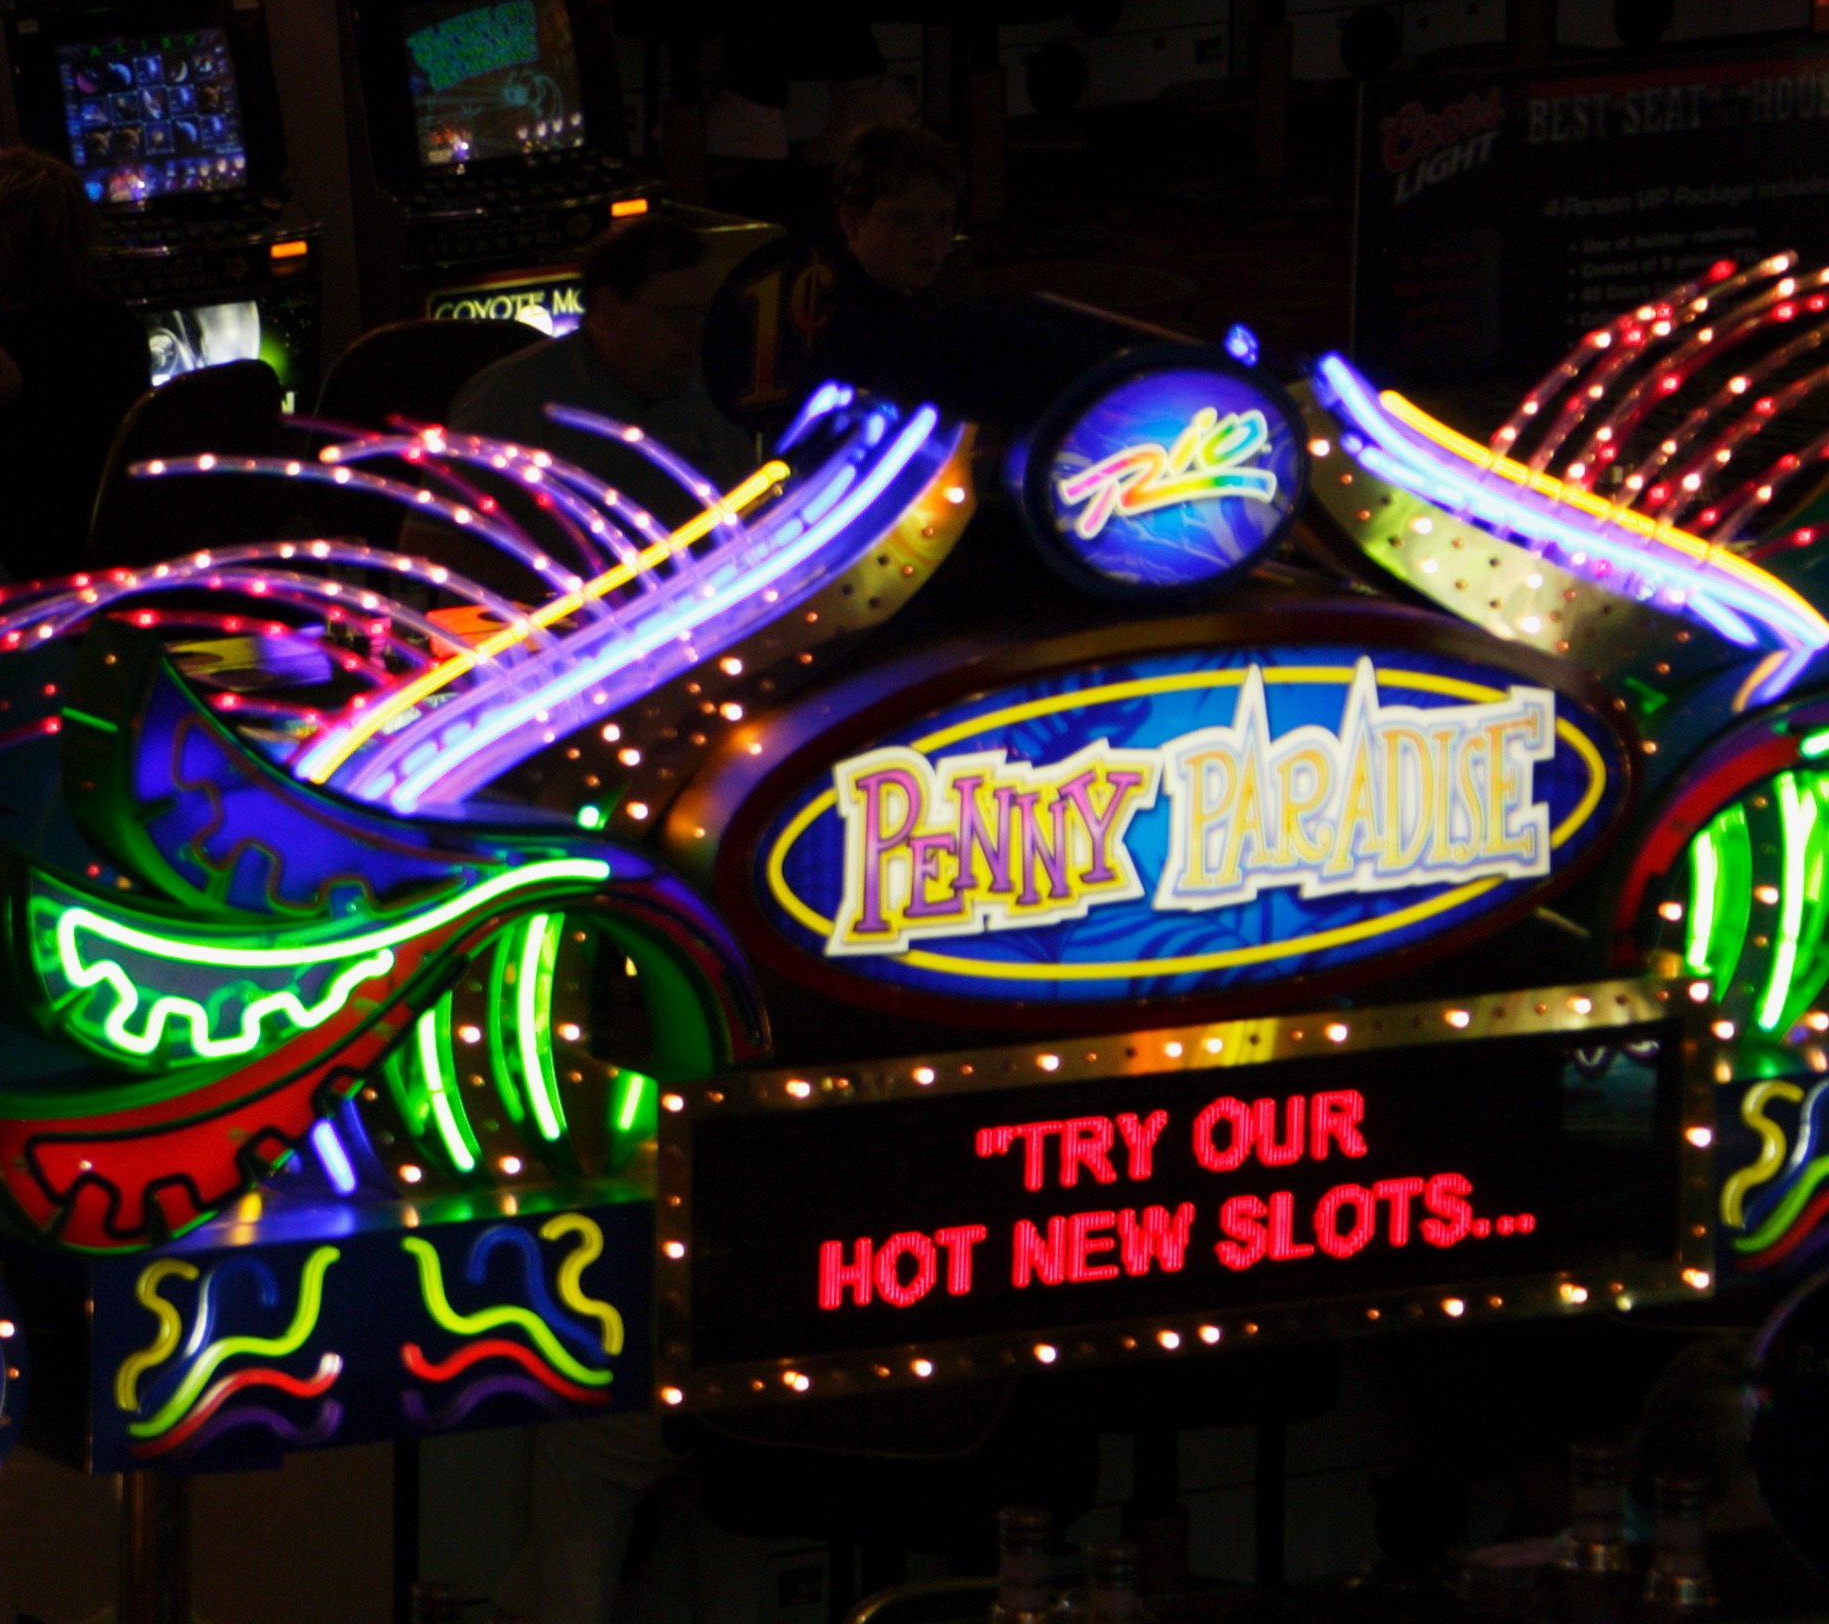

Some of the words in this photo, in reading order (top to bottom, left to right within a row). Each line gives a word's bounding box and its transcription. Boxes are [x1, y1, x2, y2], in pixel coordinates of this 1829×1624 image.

[432, 287, 545, 322] COYOTE
[1056, 407, 1279, 540] Rio
[826, 741, 1165, 956] PENNY
[1154, 656, 1556, 911] PARADISE
[975, 1107, 1169, 1192] "TRY
[1192, 1089, 1367, 1173] OUR
[817, 1223, 987, 1313] HOT
[1011, 1201, 1196, 1290] NEW
